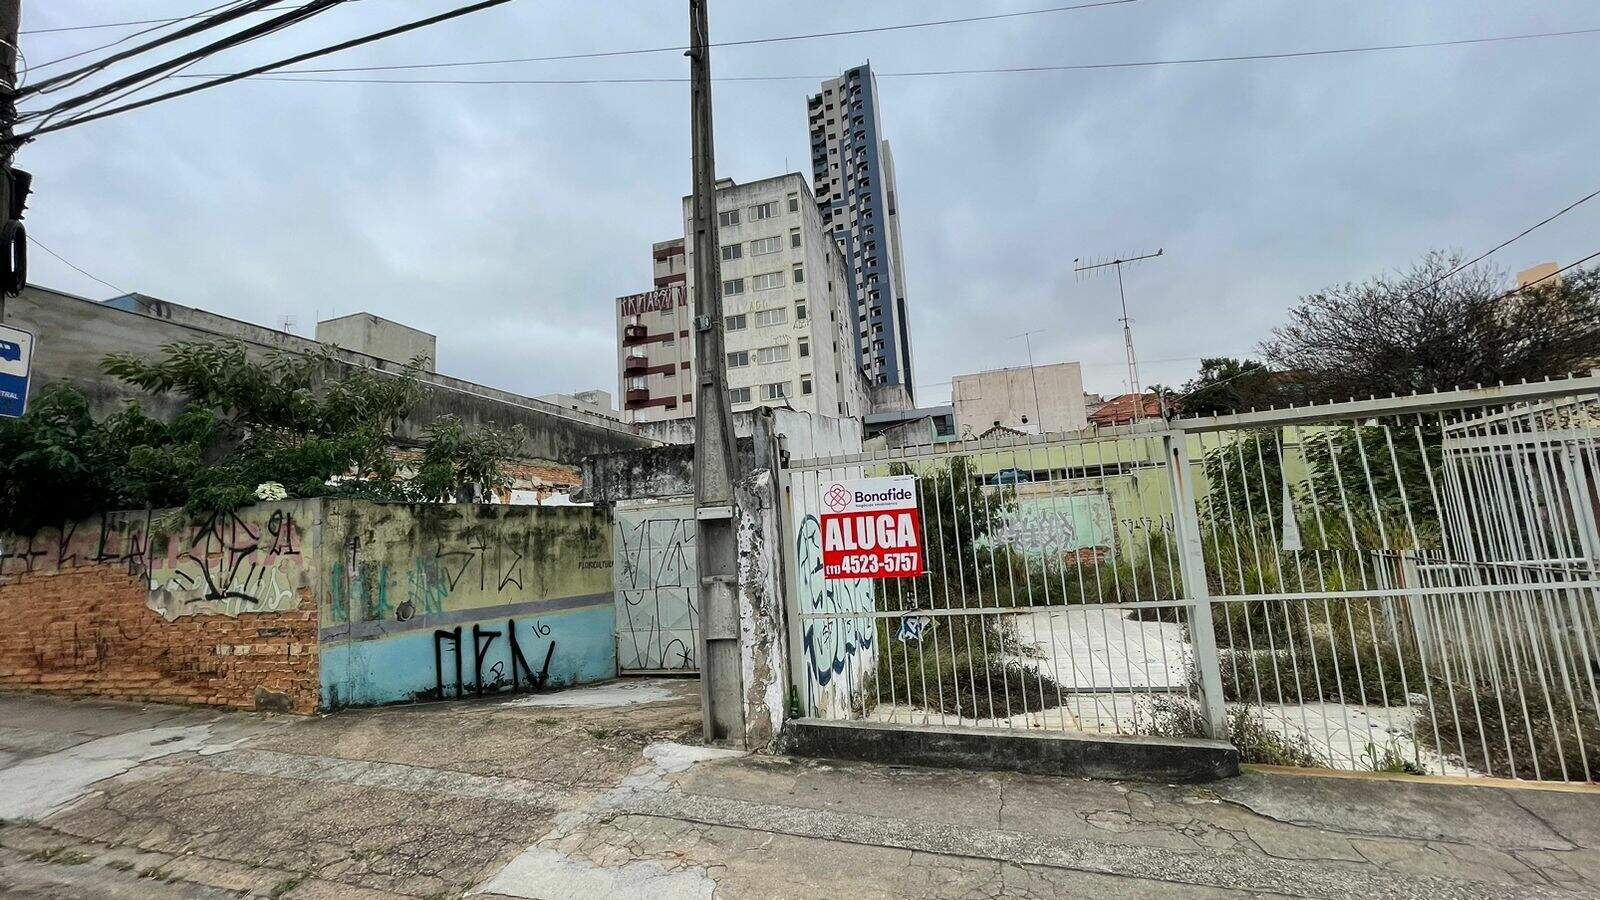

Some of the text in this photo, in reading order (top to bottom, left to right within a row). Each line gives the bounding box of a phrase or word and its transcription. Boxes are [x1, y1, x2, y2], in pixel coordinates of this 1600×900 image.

[855, 488, 912, 502] Bonafide
[825, 513, 917, 552] ALUGA
[826, 552, 918, 575] (11) 4523-5757
[532, 620, 551, 639] 16
